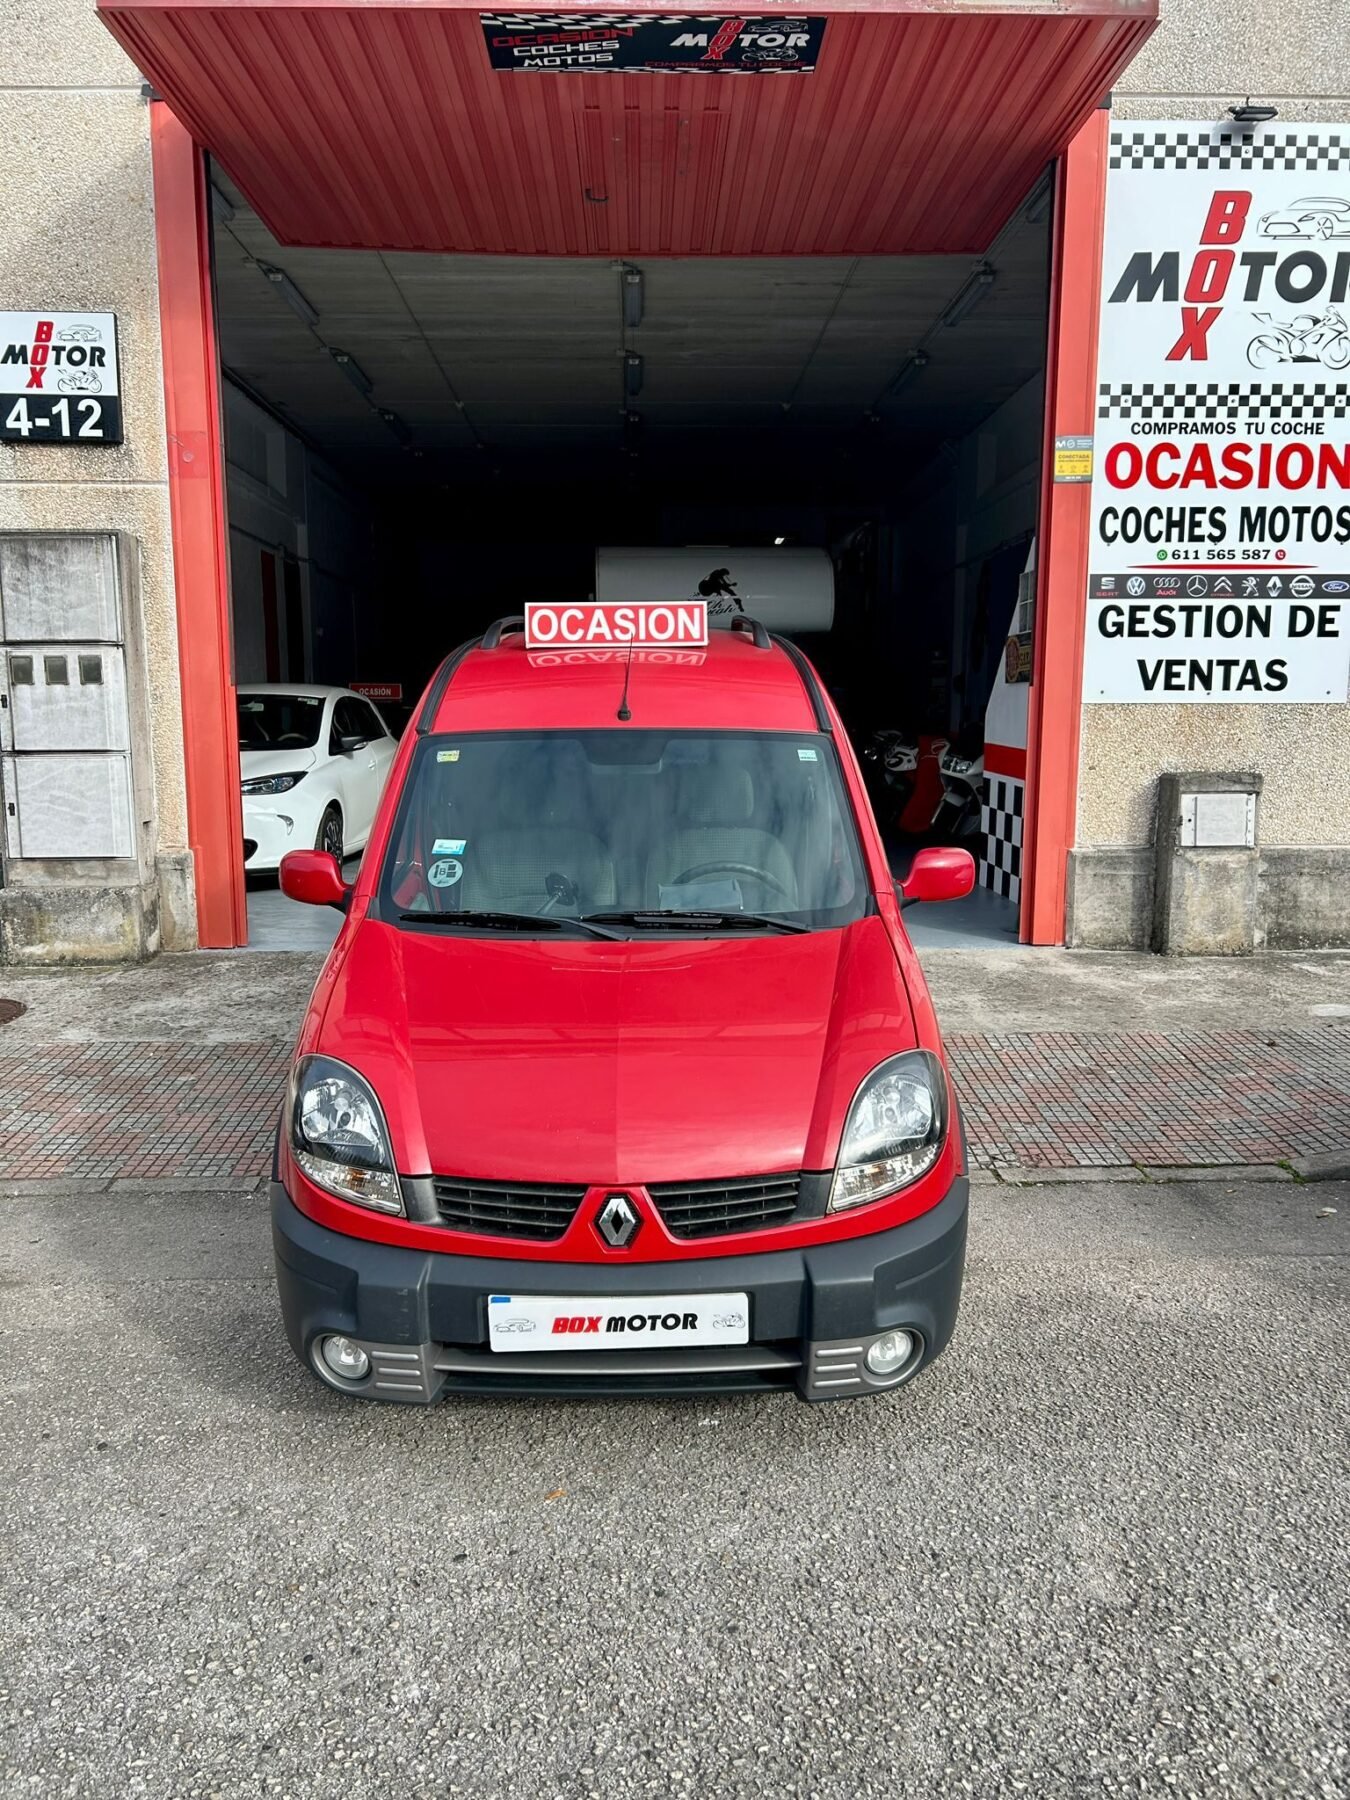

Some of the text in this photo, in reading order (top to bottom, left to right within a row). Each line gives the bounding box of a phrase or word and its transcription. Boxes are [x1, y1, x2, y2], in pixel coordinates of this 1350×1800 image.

[492, 27, 634, 47] OCASION
[513, 40, 620, 56] COCHES
[523, 53, 614, 67] MOTOS
[1165, 190, 1253, 361] BOX
[25, 321, 54, 389] BOX
[5, 397, 104, 438] 4-12
[1130, 421, 1325, 436] COMPRAMOS TU COCHE
[1104, 441, 1350, 490] OCASION
[1099, 505, 1350, 544] COCHES MOTOS
[1171, 549, 1271, 560] 611 565 587
[530, 608, 701, 641] OCASION
[1098, 604, 1342, 639] GESTION DE
[1137, 658, 1289, 692] VENTAS
[551, 1312, 699, 1334] BOX MOTOR
